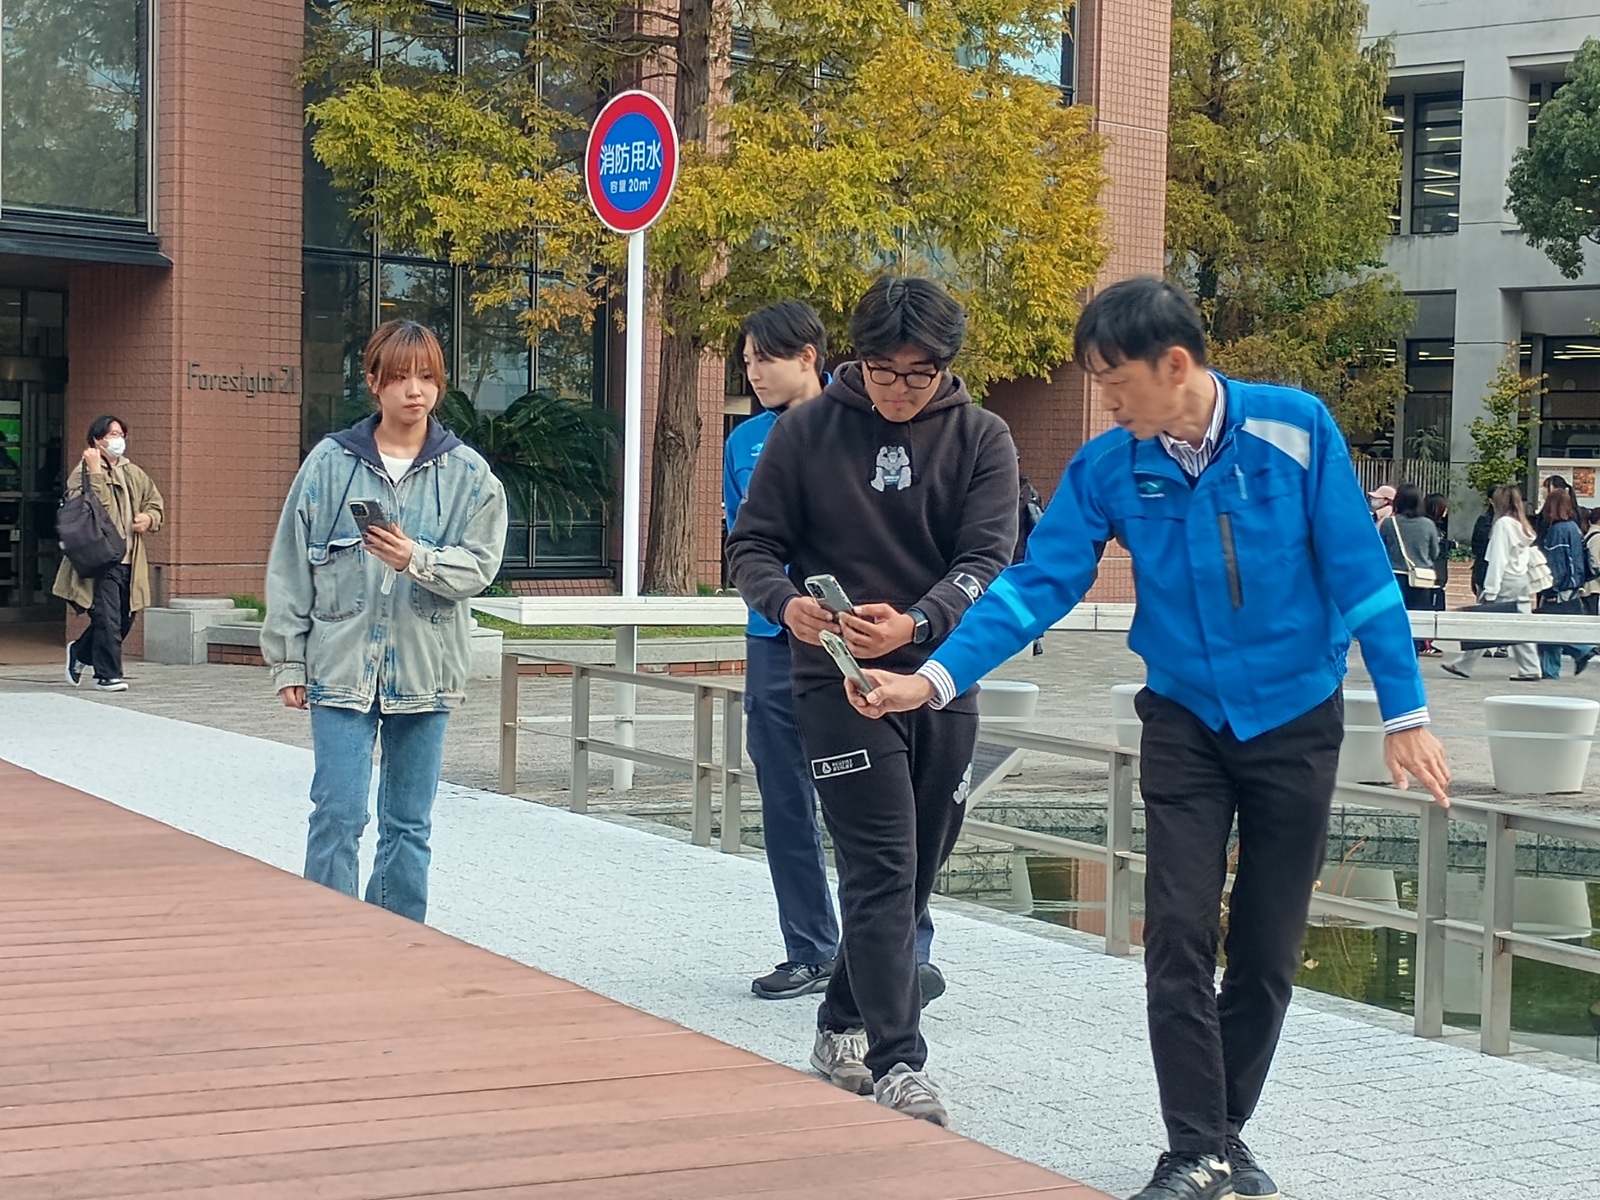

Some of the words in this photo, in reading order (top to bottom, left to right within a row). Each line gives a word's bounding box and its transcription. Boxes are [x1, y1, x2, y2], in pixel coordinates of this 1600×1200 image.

[600, 139, 662, 175] 消防用水
[187, 360, 276, 398] Foresight
